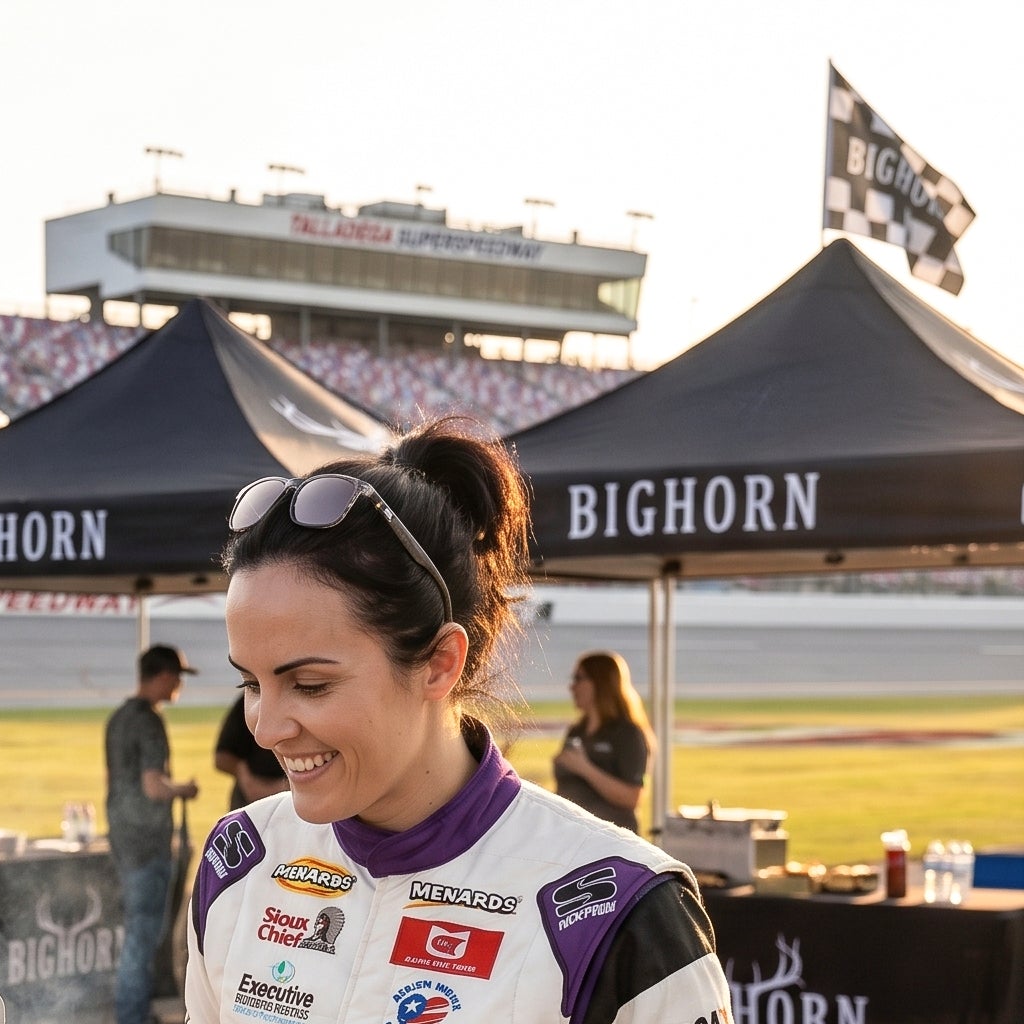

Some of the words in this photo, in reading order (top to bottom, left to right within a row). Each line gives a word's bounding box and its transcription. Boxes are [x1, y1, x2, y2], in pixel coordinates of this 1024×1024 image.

[567, 472, 820, 540] BIGHORN
[271, 863, 354, 893] MENARDS
[409, 881, 519, 915] MENARDS
[263, 906, 310, 931] Sioux
[257, 924, 305, 948] Chief
[238, 973, 314, 1008] Executive
